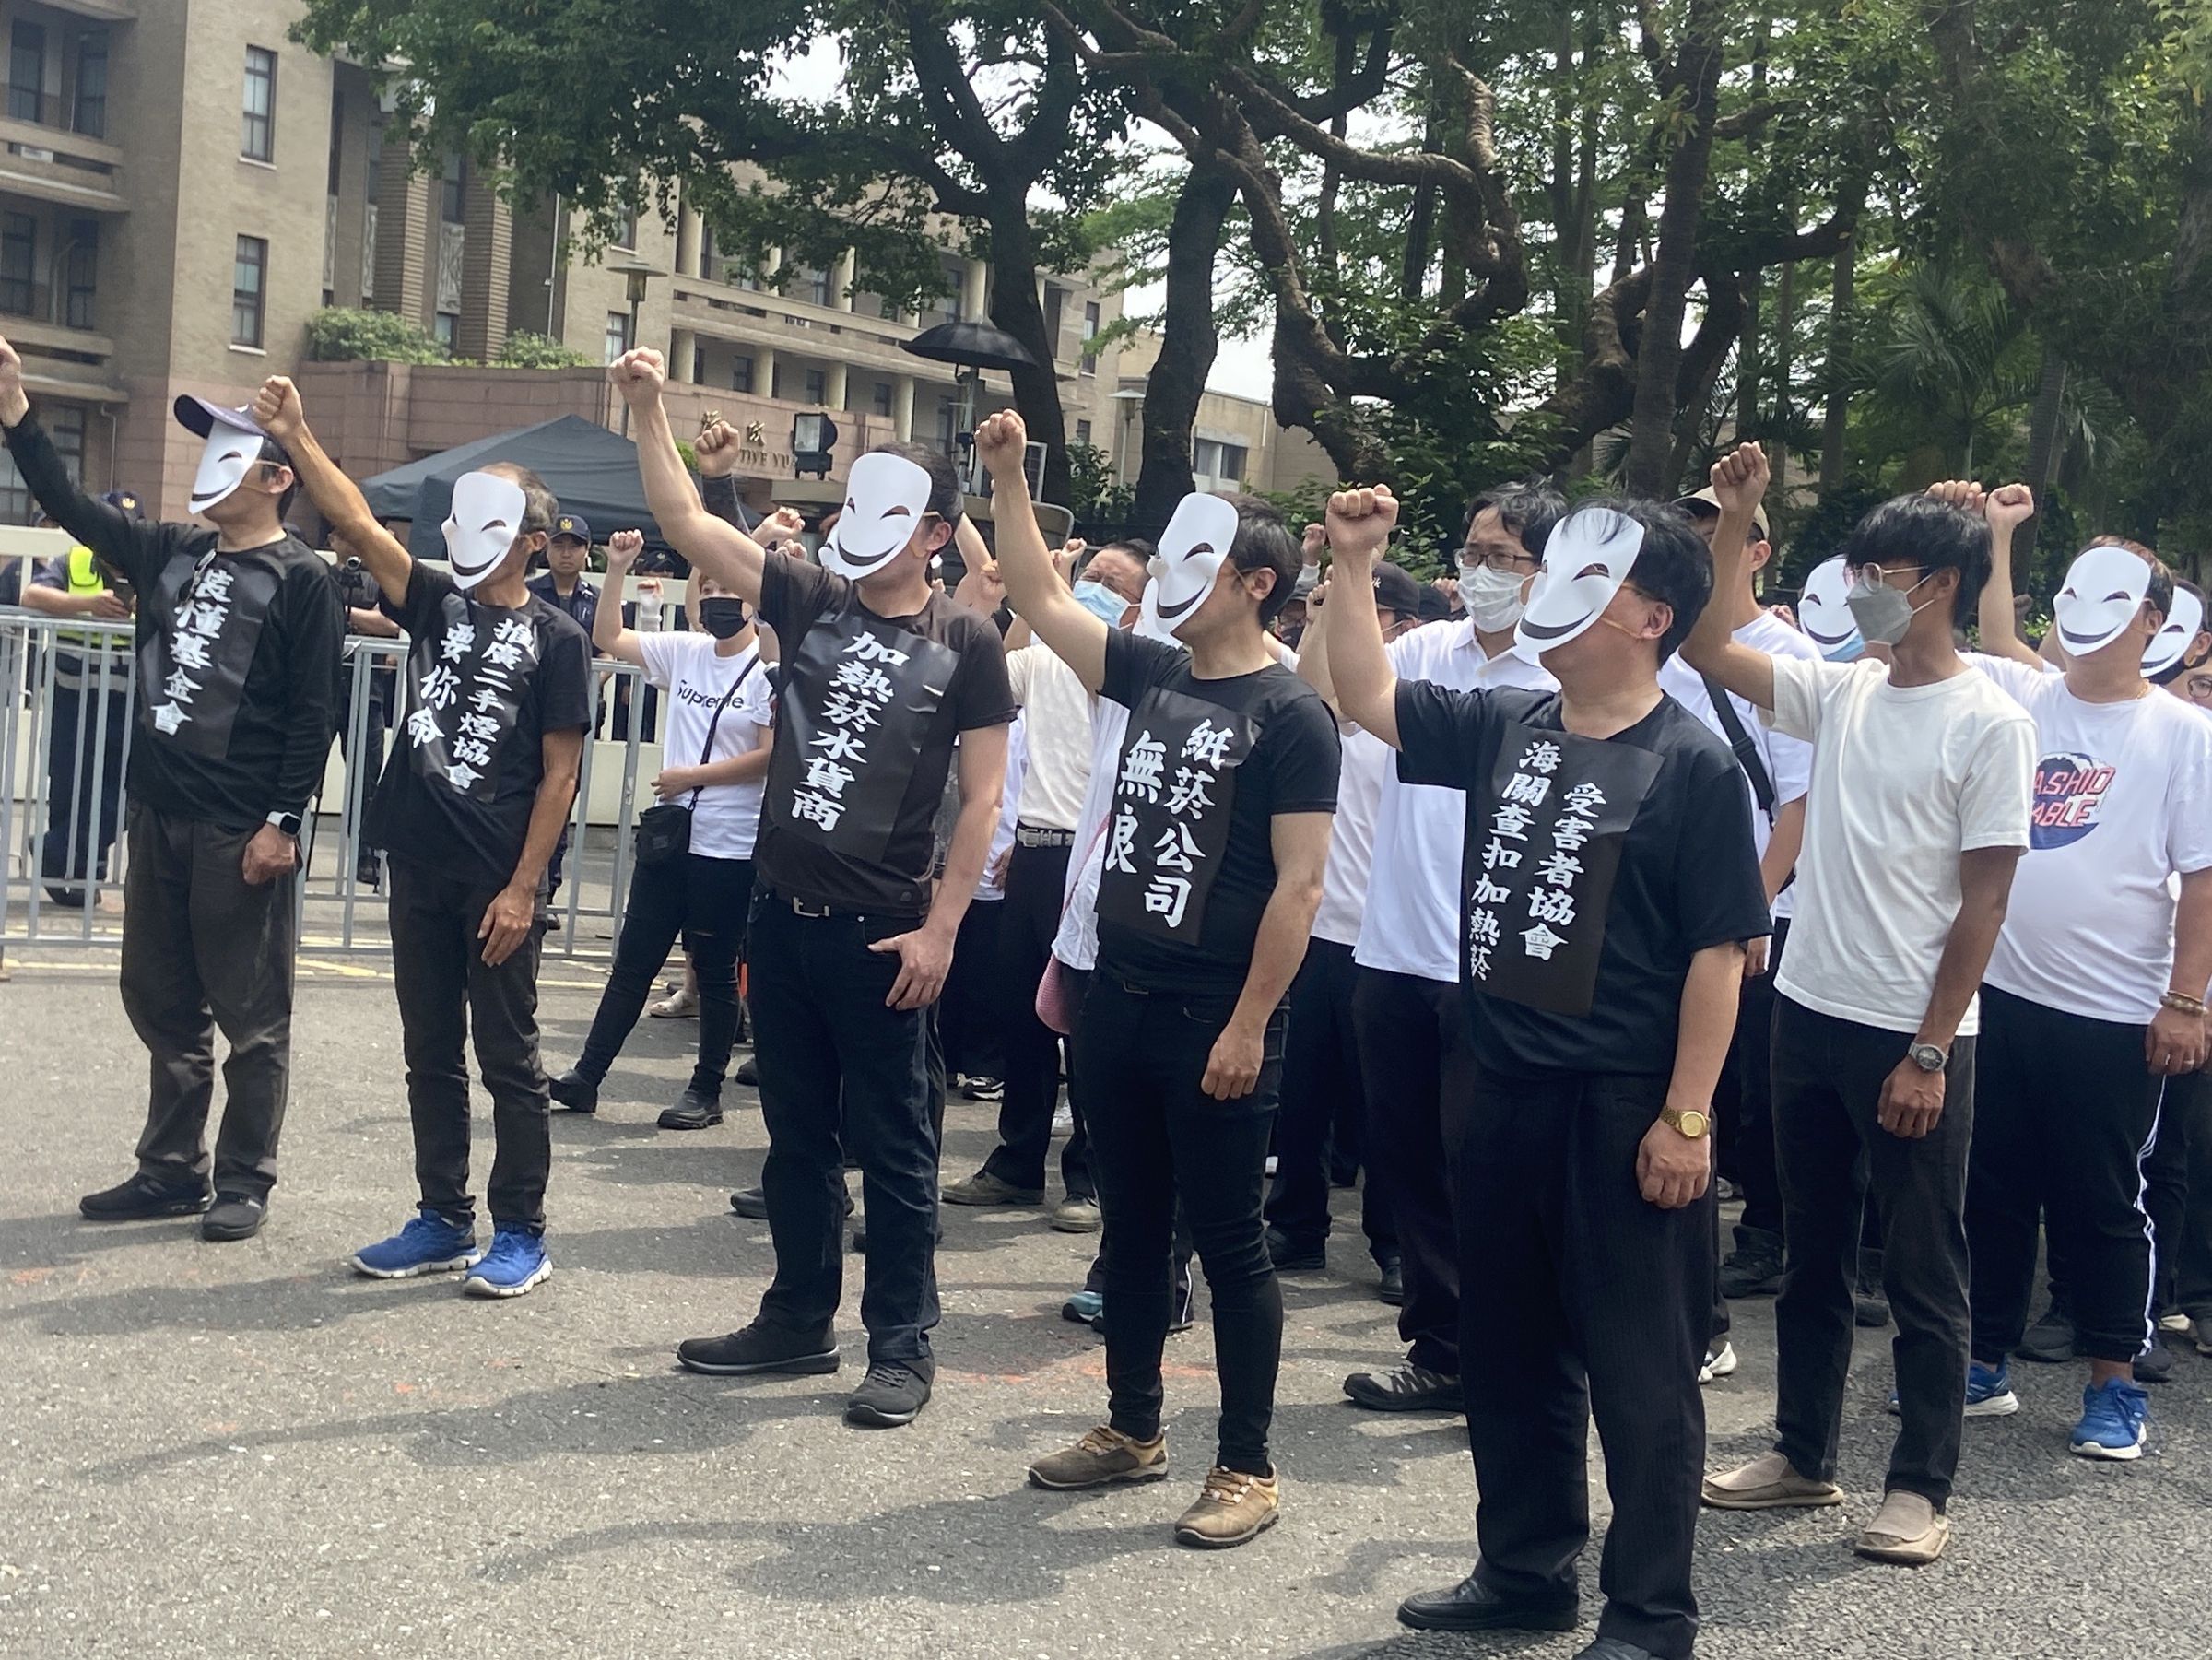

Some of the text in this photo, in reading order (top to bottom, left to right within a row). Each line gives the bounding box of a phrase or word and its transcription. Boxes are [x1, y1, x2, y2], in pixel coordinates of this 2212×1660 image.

[739, 448, 794, 468] TIVE YU
[407, 622, 476, 748] 要你命
[444, 618, 535, 790] 推廣二手煙協會
[792, 631, 910, 831] 加熱菸水貨商
[1105, 730, 1167, 873] 無良
[1144, 718, 1235, 928] 紙菸公司
[2032, 799, 2098, 828] ABLE
[2033, 767, 2116, 796] ASHIO
[1469, 740, 1562, 981] 海關查扣加熱菸
[1519, 783, 1606, 960] 受害者協會
